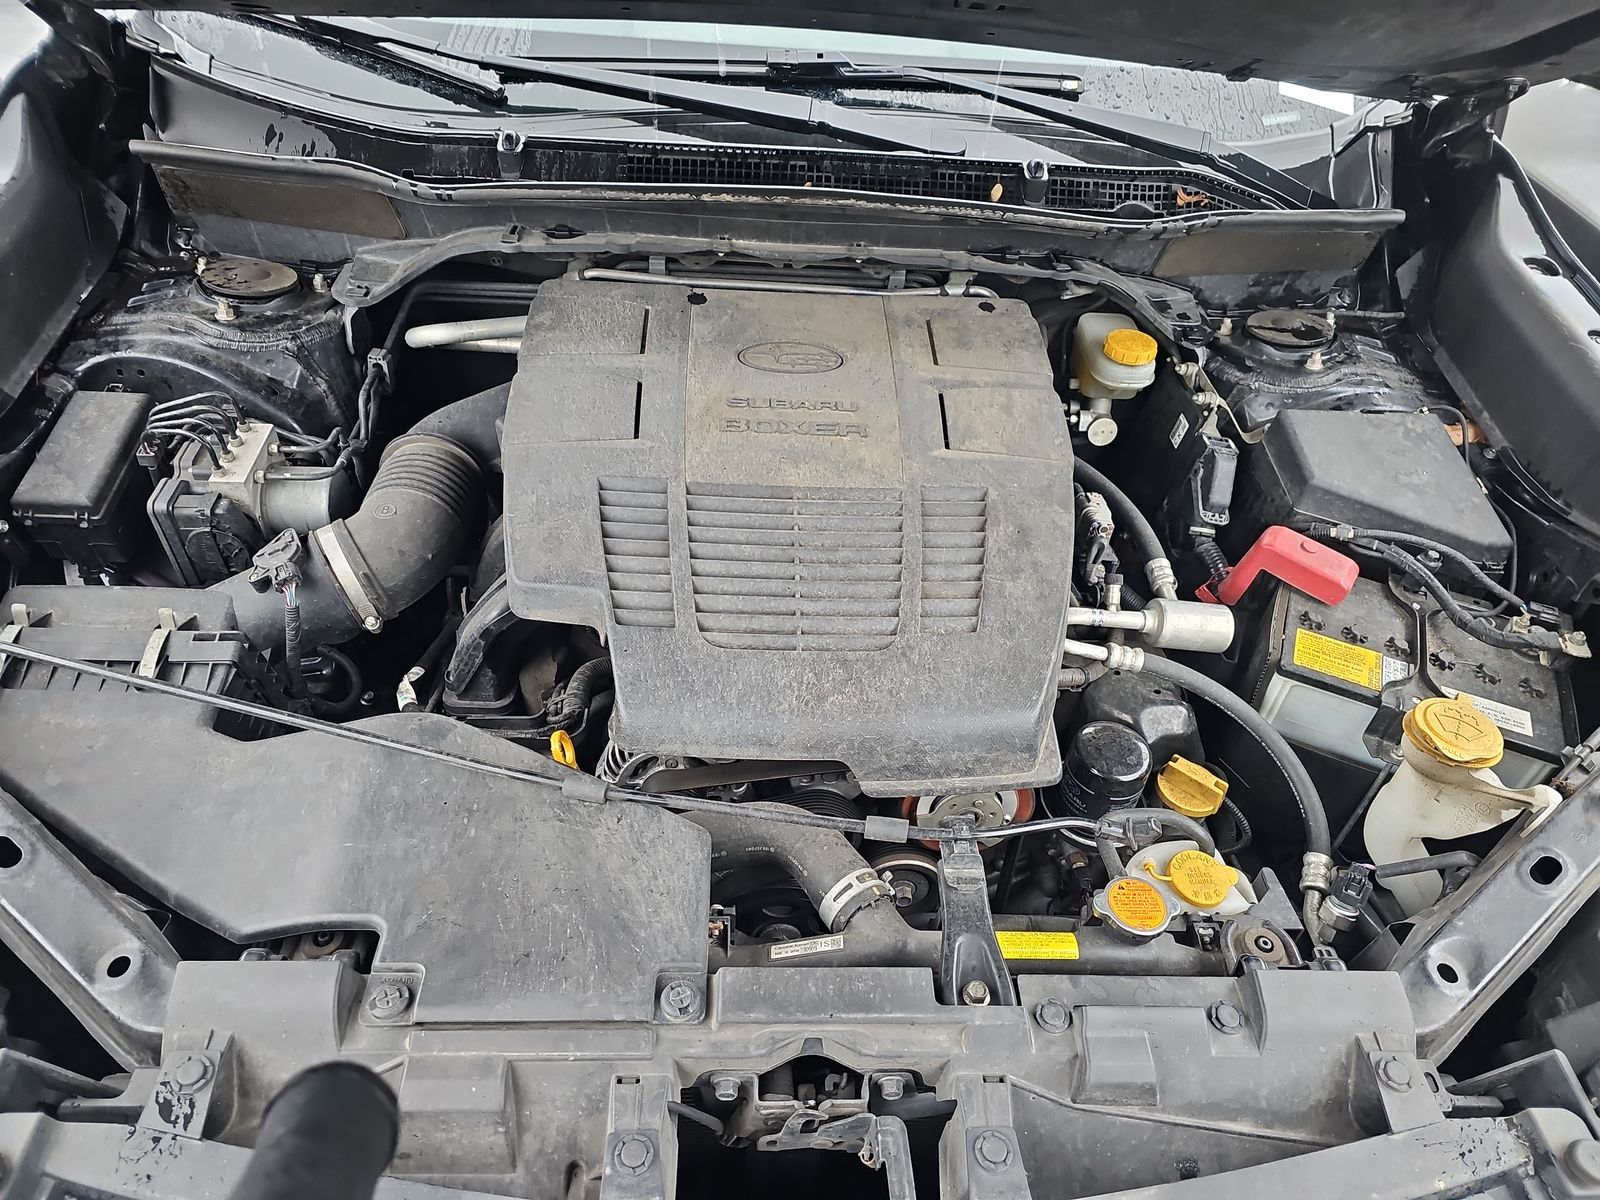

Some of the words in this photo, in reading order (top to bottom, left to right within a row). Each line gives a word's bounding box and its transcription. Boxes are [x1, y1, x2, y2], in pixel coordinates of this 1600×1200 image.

[726, 397, 859, 412] SUBARU
[720, 419, 868, 437] BOXER
[1172, 852, 1217, 870] COOLANT
